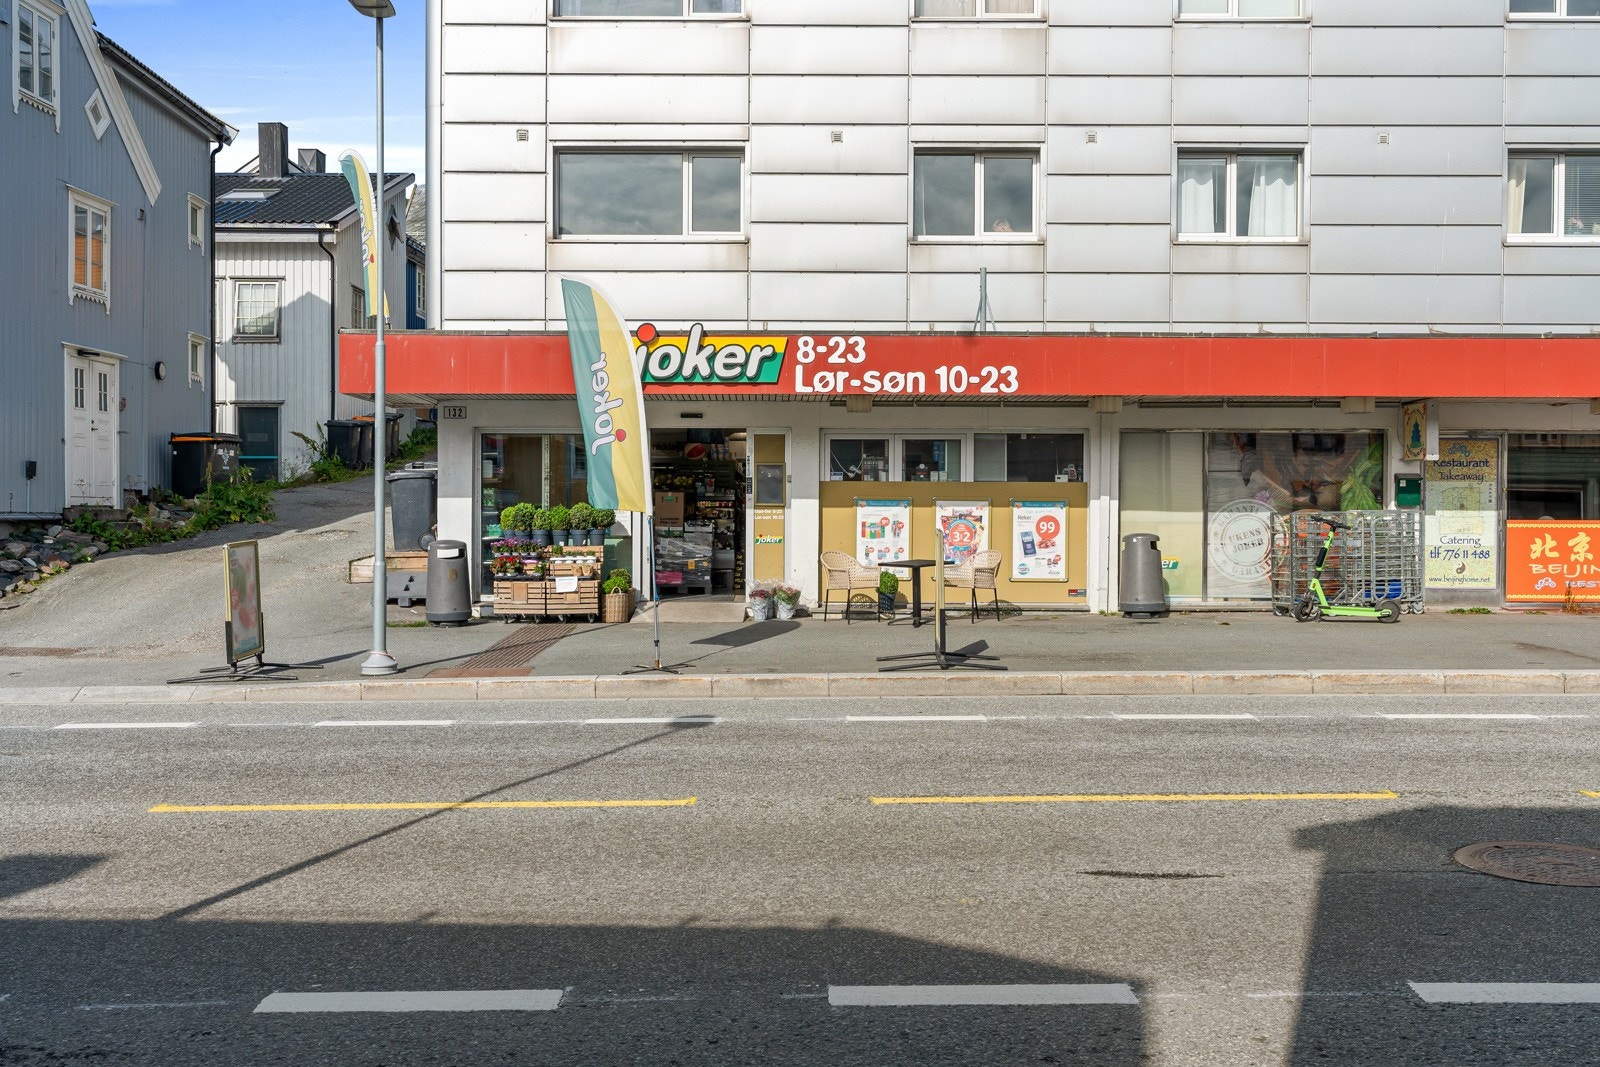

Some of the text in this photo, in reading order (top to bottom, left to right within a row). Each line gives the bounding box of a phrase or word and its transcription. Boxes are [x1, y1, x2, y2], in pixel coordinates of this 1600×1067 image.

[797, 336, 866, 364] 8-23
[795, 365, 1019, 393] Lør-søn 10-23
[448, 408, 463, 417] 132
[1438, 469, 1484, 485] Takeaway
[1040, 522, 1056, 534] 99
[756, 534, 781, 544] joker
[953, 532, 970, 542] 3 2
[1228, 528, 1262, 543] UKENS
[1440, 536, 1481, 548] Catering
[1430, 546, 1490, 560] tlf 776 11 488
[1530, 531, 1593, 562] 北京
[1428, 574, 1490, 586] www.beijinghome.net
